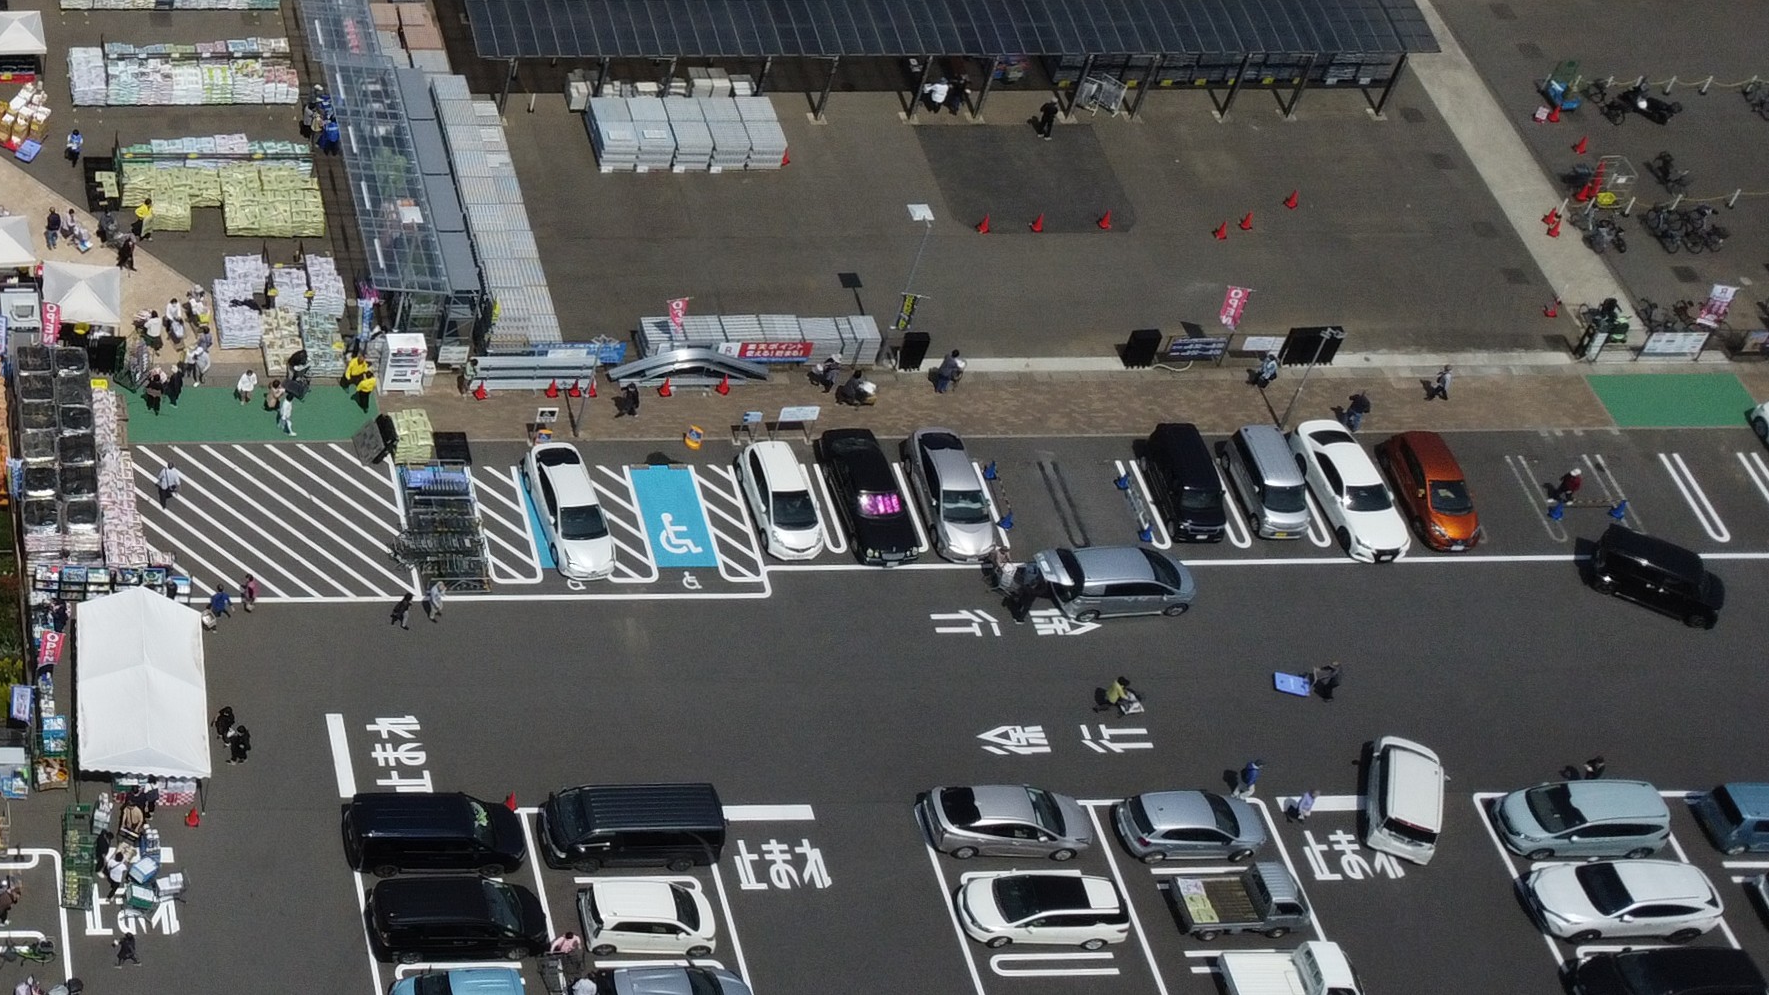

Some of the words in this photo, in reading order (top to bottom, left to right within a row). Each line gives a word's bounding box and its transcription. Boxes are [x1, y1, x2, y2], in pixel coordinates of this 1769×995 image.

[43, 632, 59, 663] OPEN
[366, 714, 434, 793] 止まれ
[976, 722, 1154, 754] 徐行
[734, 838, 832, 890] 止まれ
